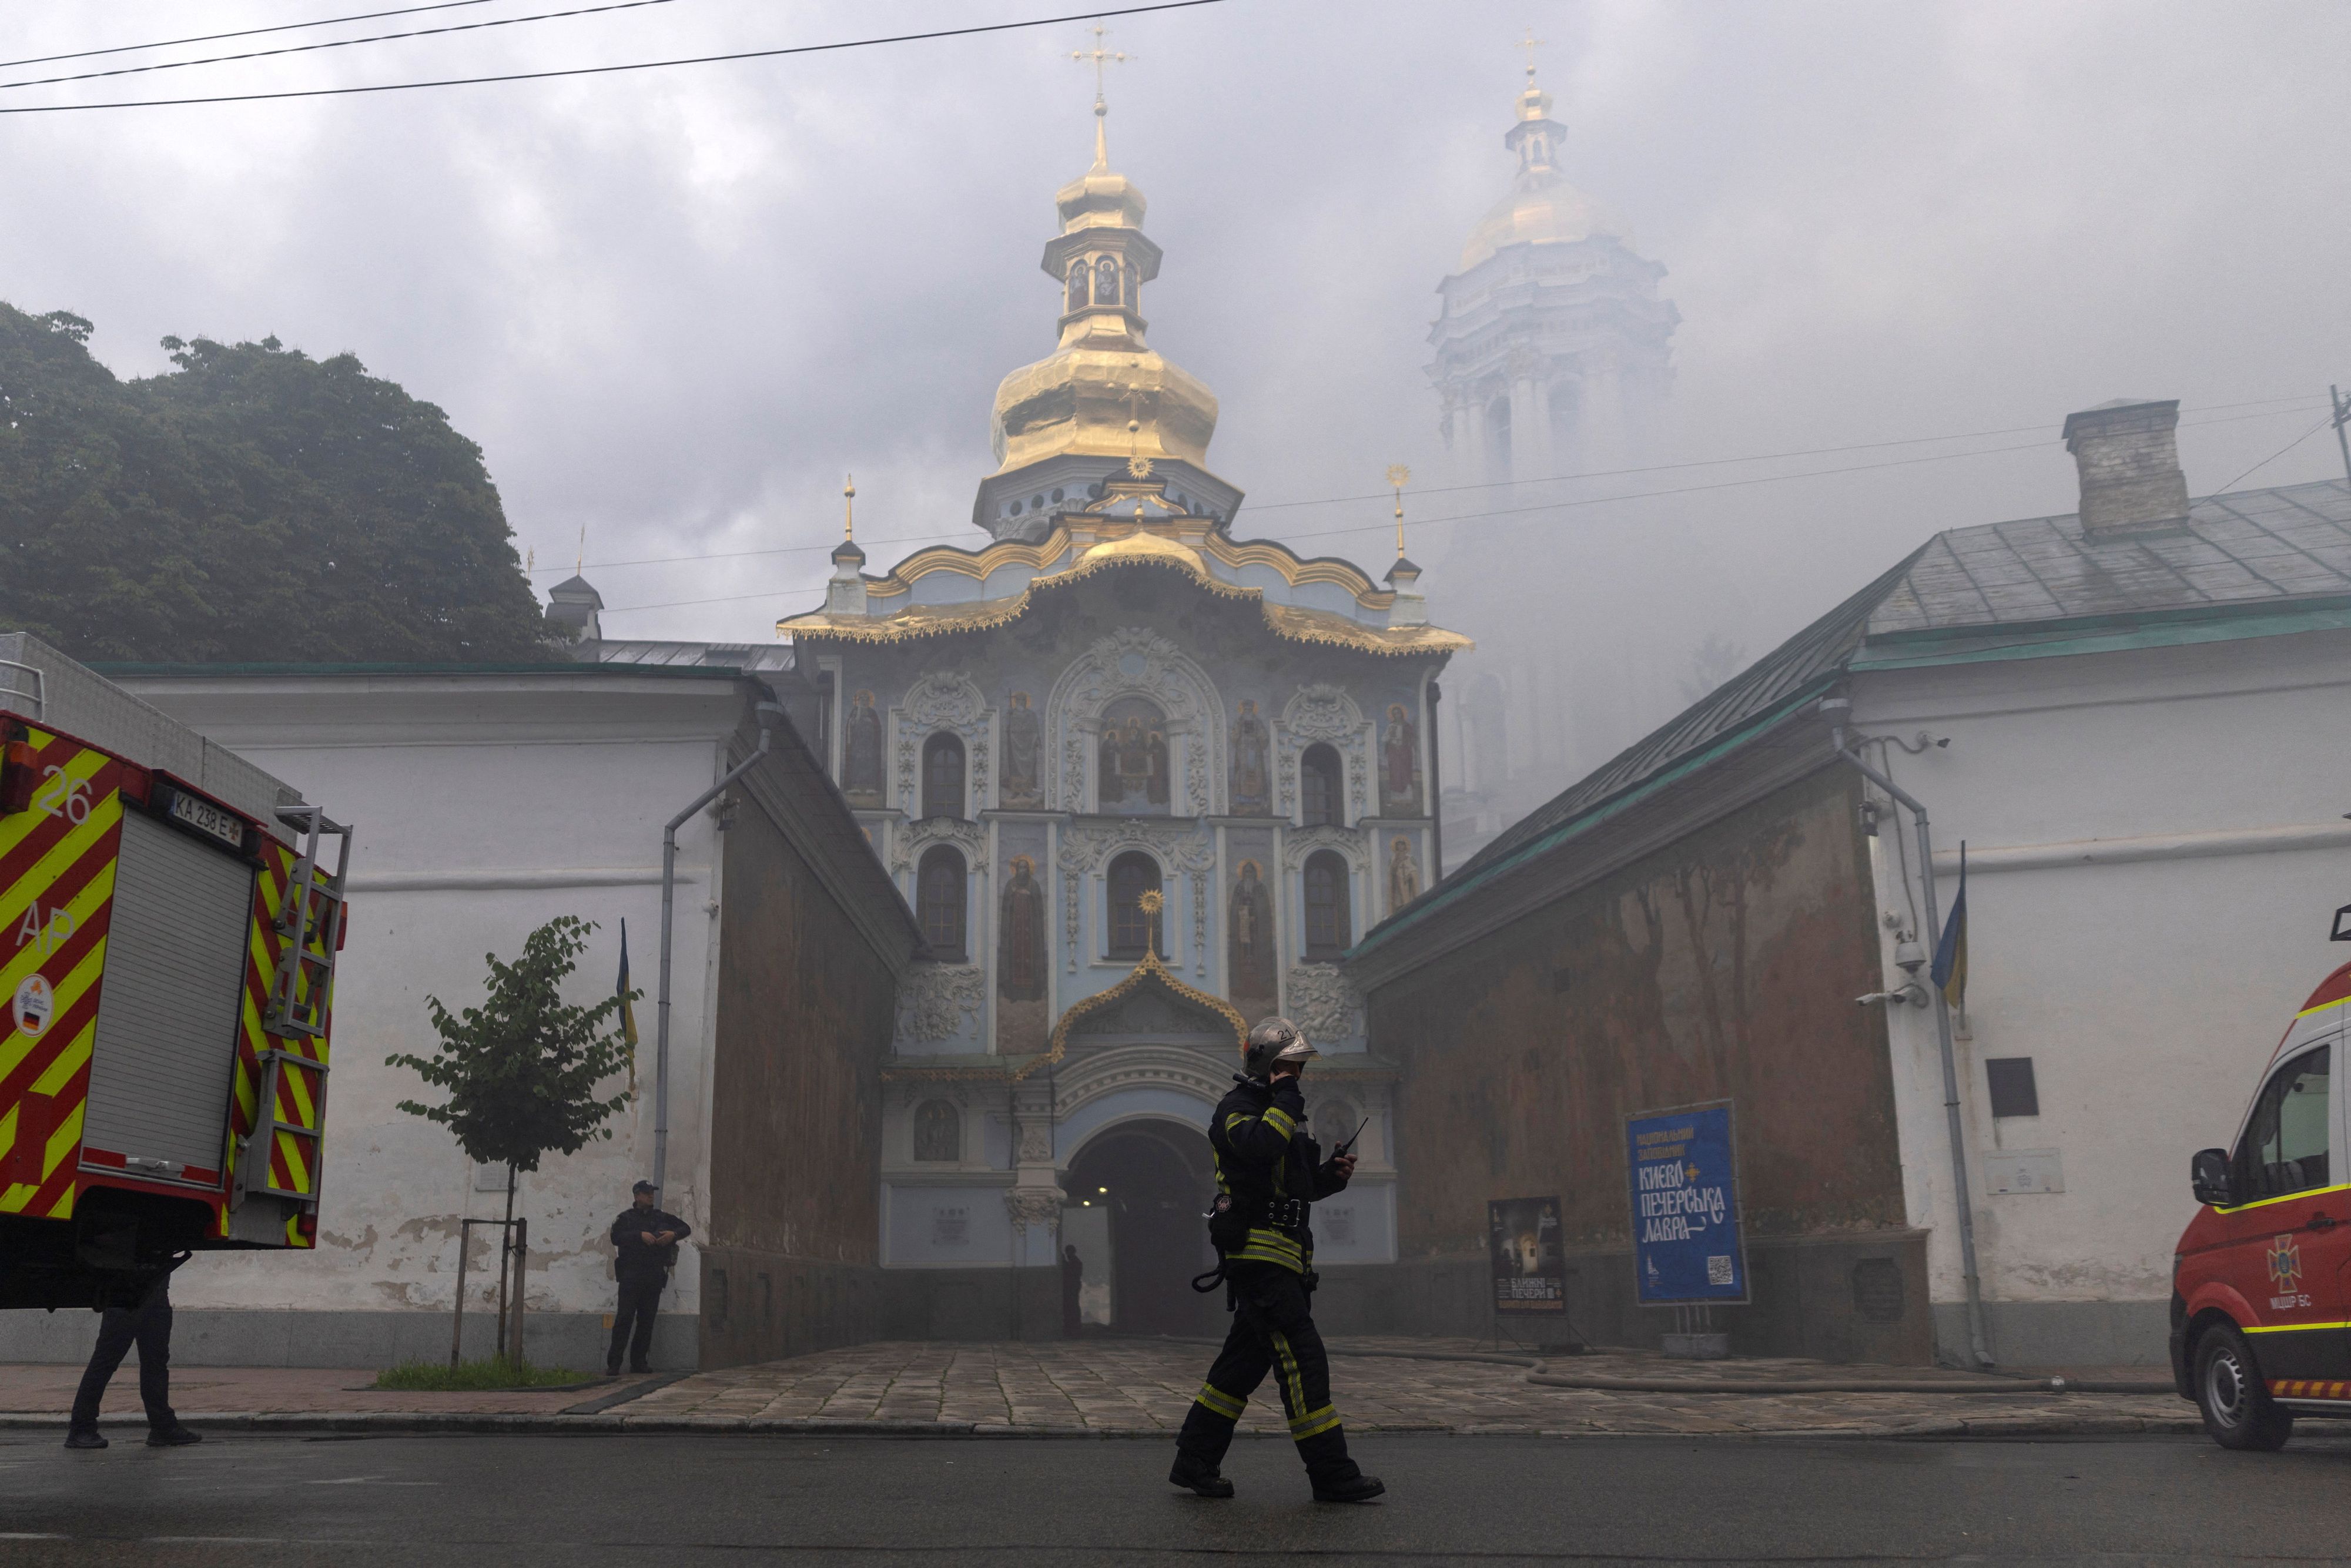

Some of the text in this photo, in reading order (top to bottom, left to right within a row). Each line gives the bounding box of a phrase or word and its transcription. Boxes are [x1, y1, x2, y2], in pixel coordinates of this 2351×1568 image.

[38, 765, 92, 825] 26
[176, 795, 192, 820] KA
[197, 805, 216, 830] 238
[219, 816, 227, 836] E
[1278, 1028, 1292, 1040] 21
[1636, 1125, 1694, 1145] НАЦІОНАЛЬНИЙ
[1637, 1144, 1685, 1161] ЗАПОВІДНИК
[1639, 1160, 1684, 1190] КИЄВО
[1641, 1185, 1726, 1224] ПЕЧЕРСЬКА
[1642, 1216, 1707, 1243] ЛАВРА
[1511, 1278, 1546, 1288] БЛИЖНІ
[1512, 1288, 1546, 1298] ПЕЧЕРИ
